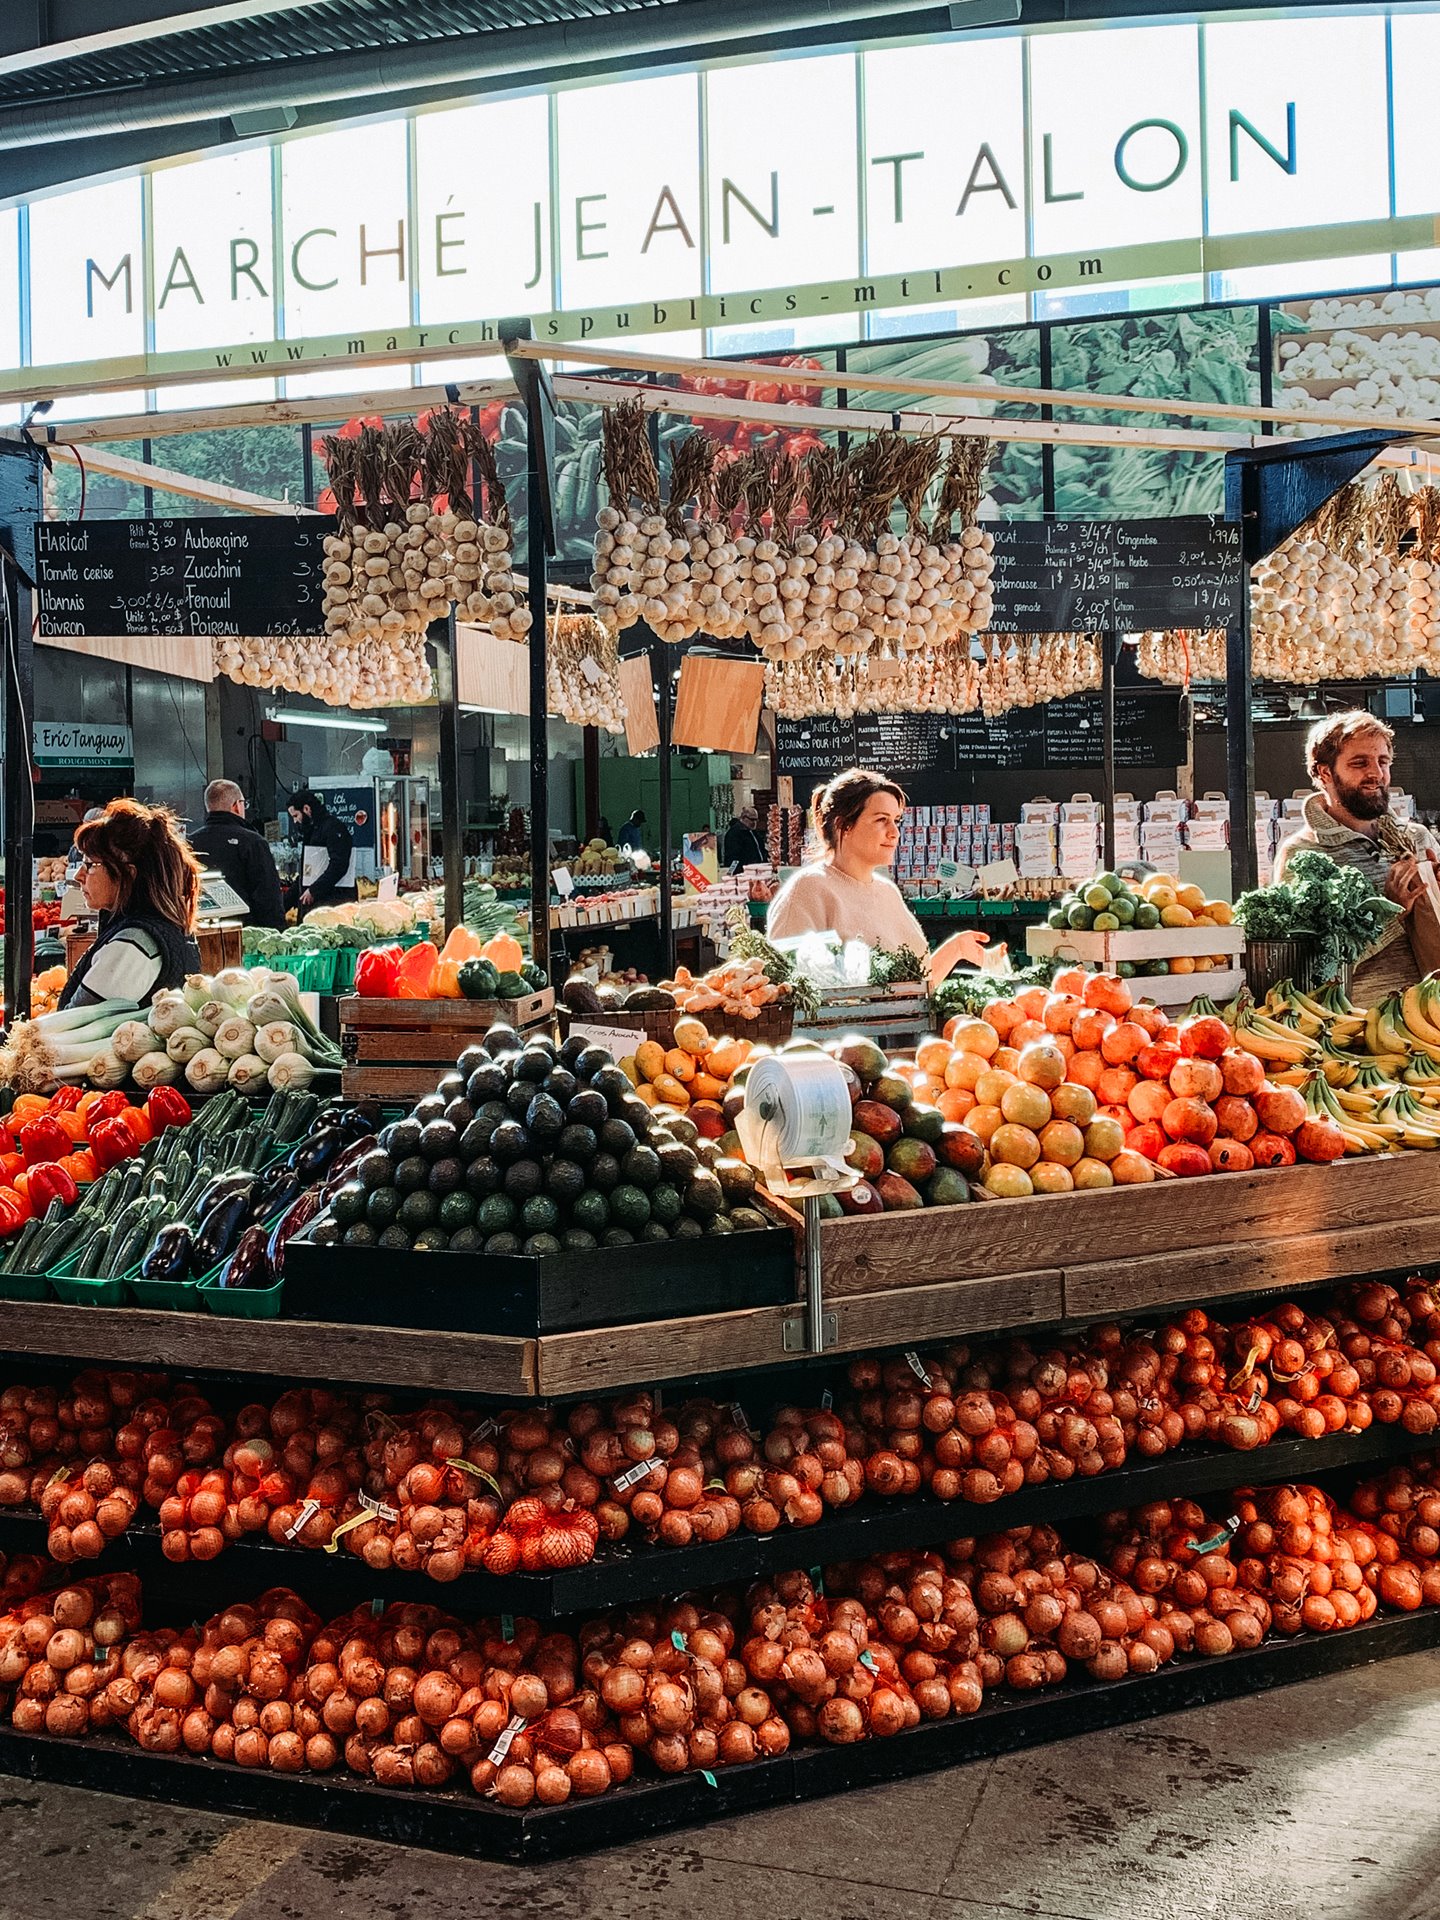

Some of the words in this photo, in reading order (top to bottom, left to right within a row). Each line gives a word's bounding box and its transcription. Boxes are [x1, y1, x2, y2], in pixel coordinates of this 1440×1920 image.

[86, 195, 467, 318] MARCHÉ
[215, 254, 1105, 367] www.marchspublics-mtl.com
[184, 555, 241, 578] Zucchini
[185, 584, 230, 609] Fenouil
[43, 729, 71, 748] Eric
[72, 729, 126, 754] Tanguay
[778, 739, 784, 750] 3
